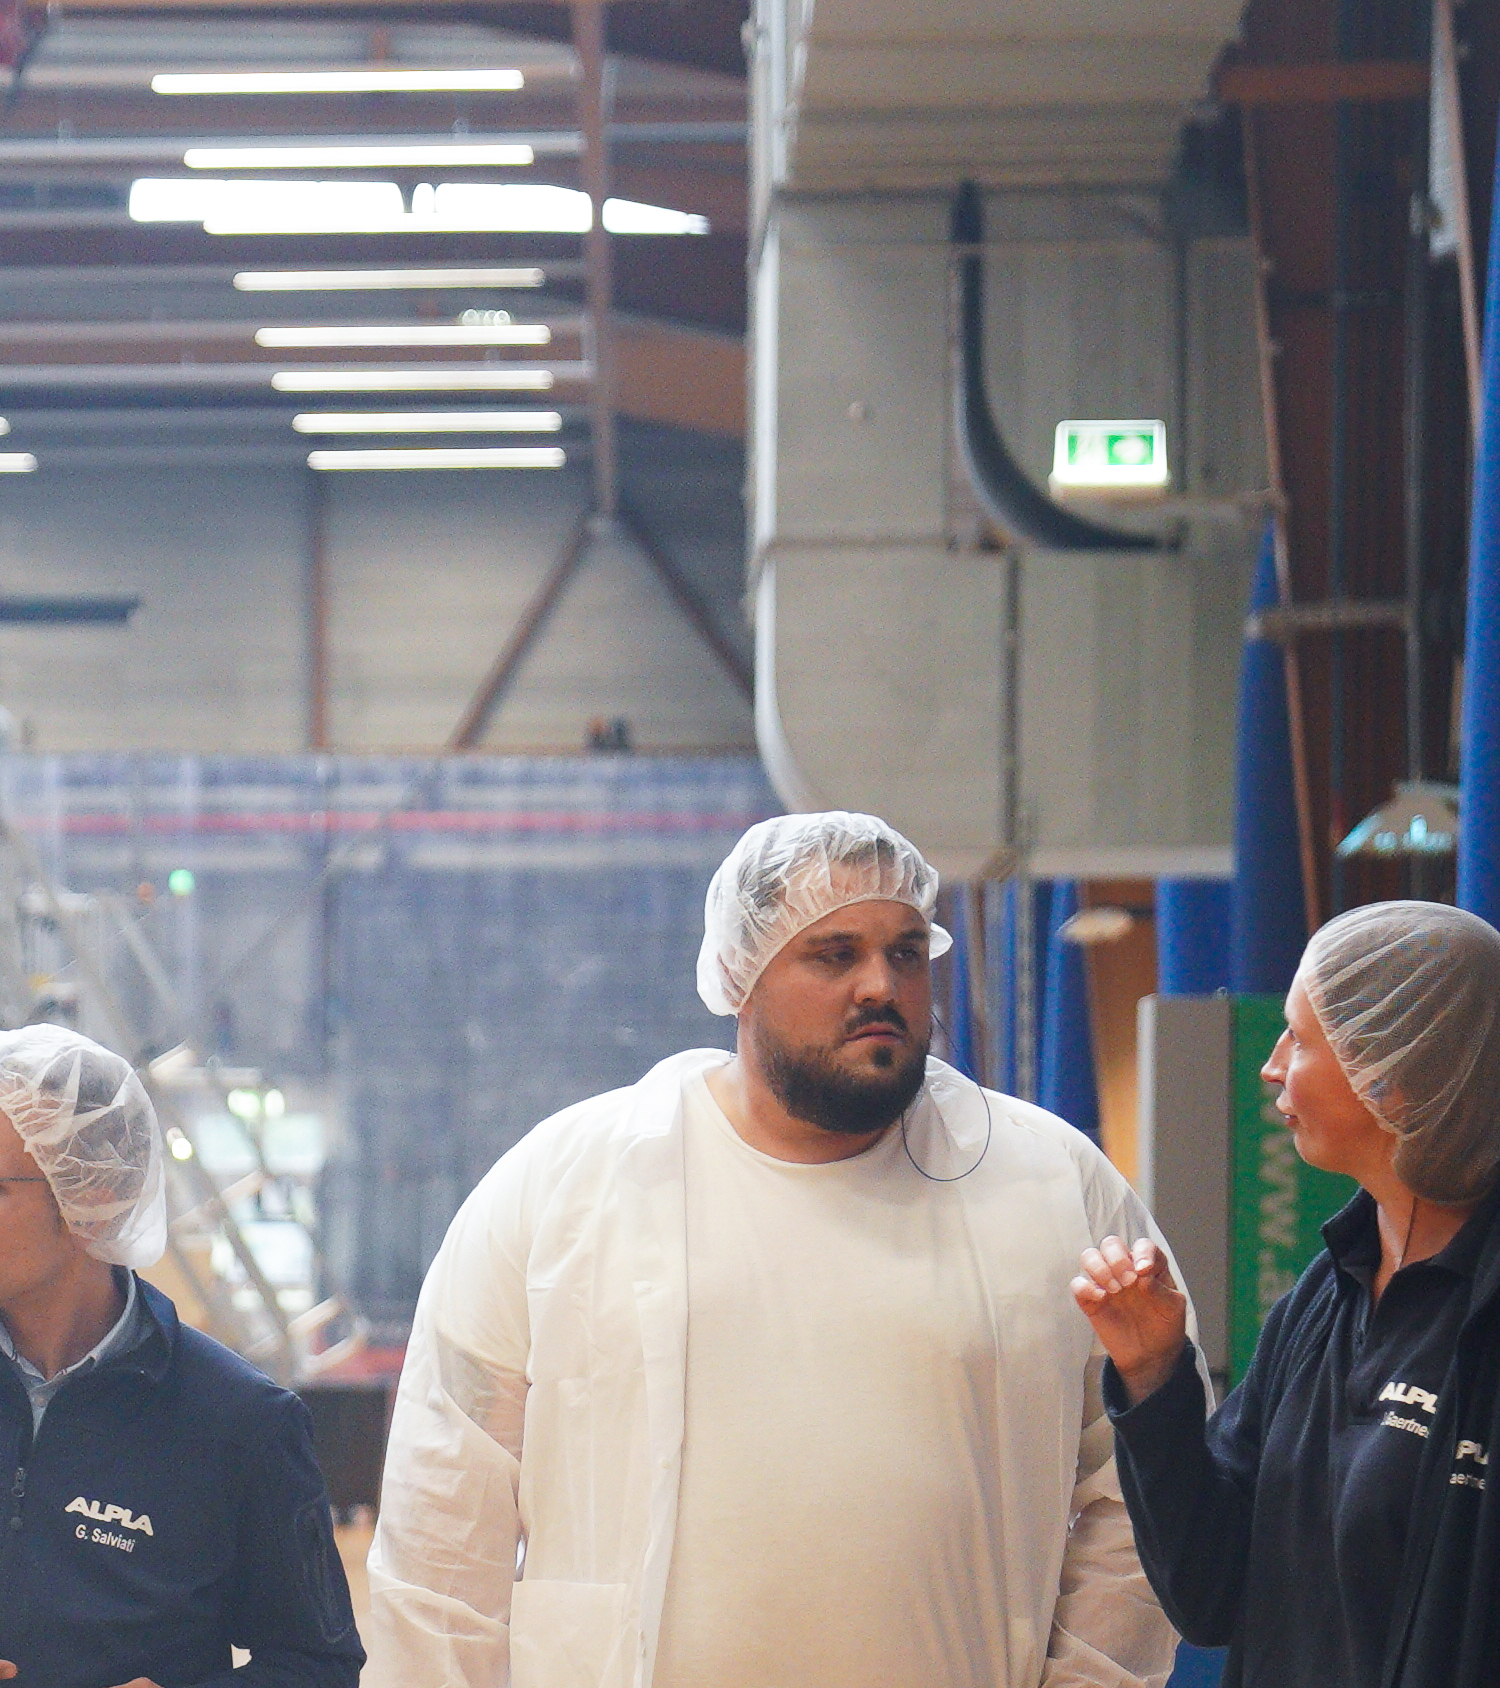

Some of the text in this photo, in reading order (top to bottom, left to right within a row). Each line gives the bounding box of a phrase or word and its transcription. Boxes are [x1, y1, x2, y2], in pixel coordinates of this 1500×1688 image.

[1379, 1381, 1438, 1415] ALPL
[65, 1496, 154, 1536] ALPLA
[75, 1524, 136, 1553] G. Salviati
